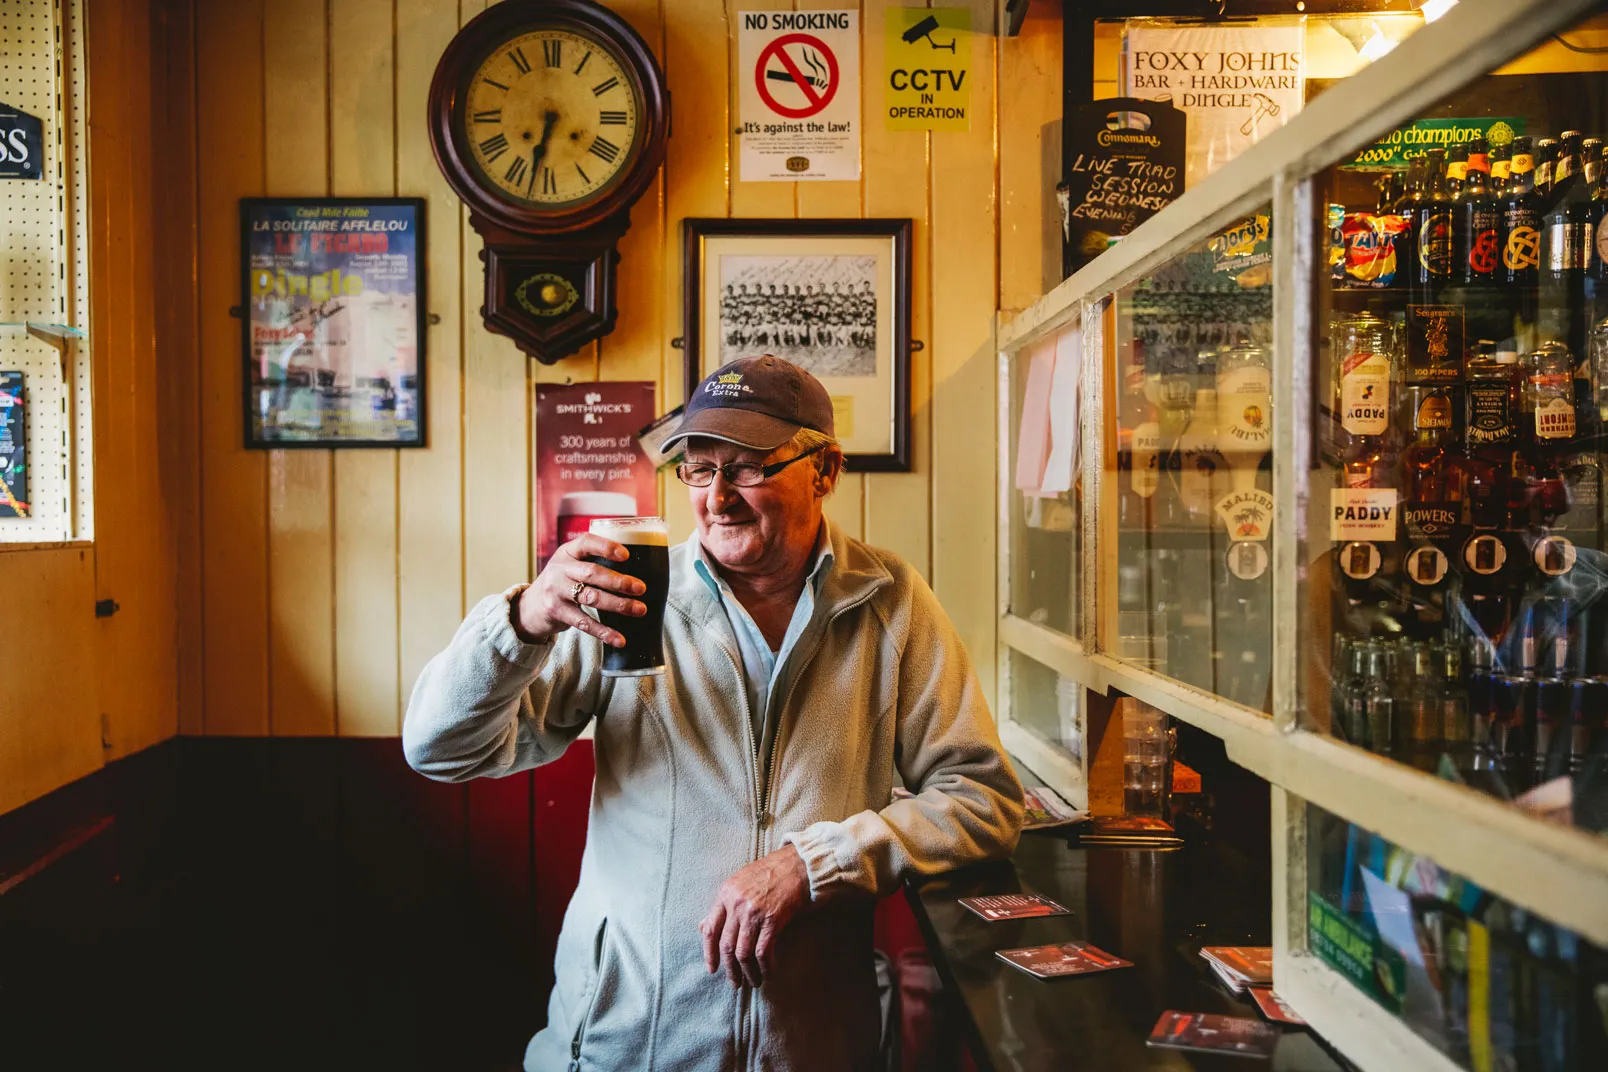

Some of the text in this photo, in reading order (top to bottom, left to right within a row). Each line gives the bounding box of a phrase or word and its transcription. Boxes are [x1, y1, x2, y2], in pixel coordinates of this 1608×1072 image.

[745, 13, 849, 30] NO SMOKING
[1134, 51, 1209, 71] FOXY
[890, 69, 966, 91] CCTV
[1134, 75, 1170, 88] BAR
[921, 93, 934, 104] IN
[1182, 93, 1252, 108] DINGLE
[889, 107, 965, 119] OPERATION
[744, 121, 850, 136] It's against the law!
[1404, 125, 1482, 148] champions
[1128, 161, 1176, 179] TRAD
[1091, 174, 1174, 194] SESSION
[1072, 203, 1136, 223] EVENING
[253, 220, 408, 231] LA SOLITAIRE AFFLELOU
[311, 233, 389, 253] FIGARO
[251, 268, 363, 301] Dingle
[704, 381, 754, 393] Corona
[712, 389, 739, 397] Extra
[556, 404, 632, 414] SMITHWICK'S
[1347, 408, 1385, 419] PADDY
[560, 435, 631, 450] 300 years of
[555, 452, 637, 464] craftsmanship
[561, 467, 634, 481] in every pint.
[1334, 506, 1392, 520] PADDY
[1404, 509, 1455, 524] POWERS
